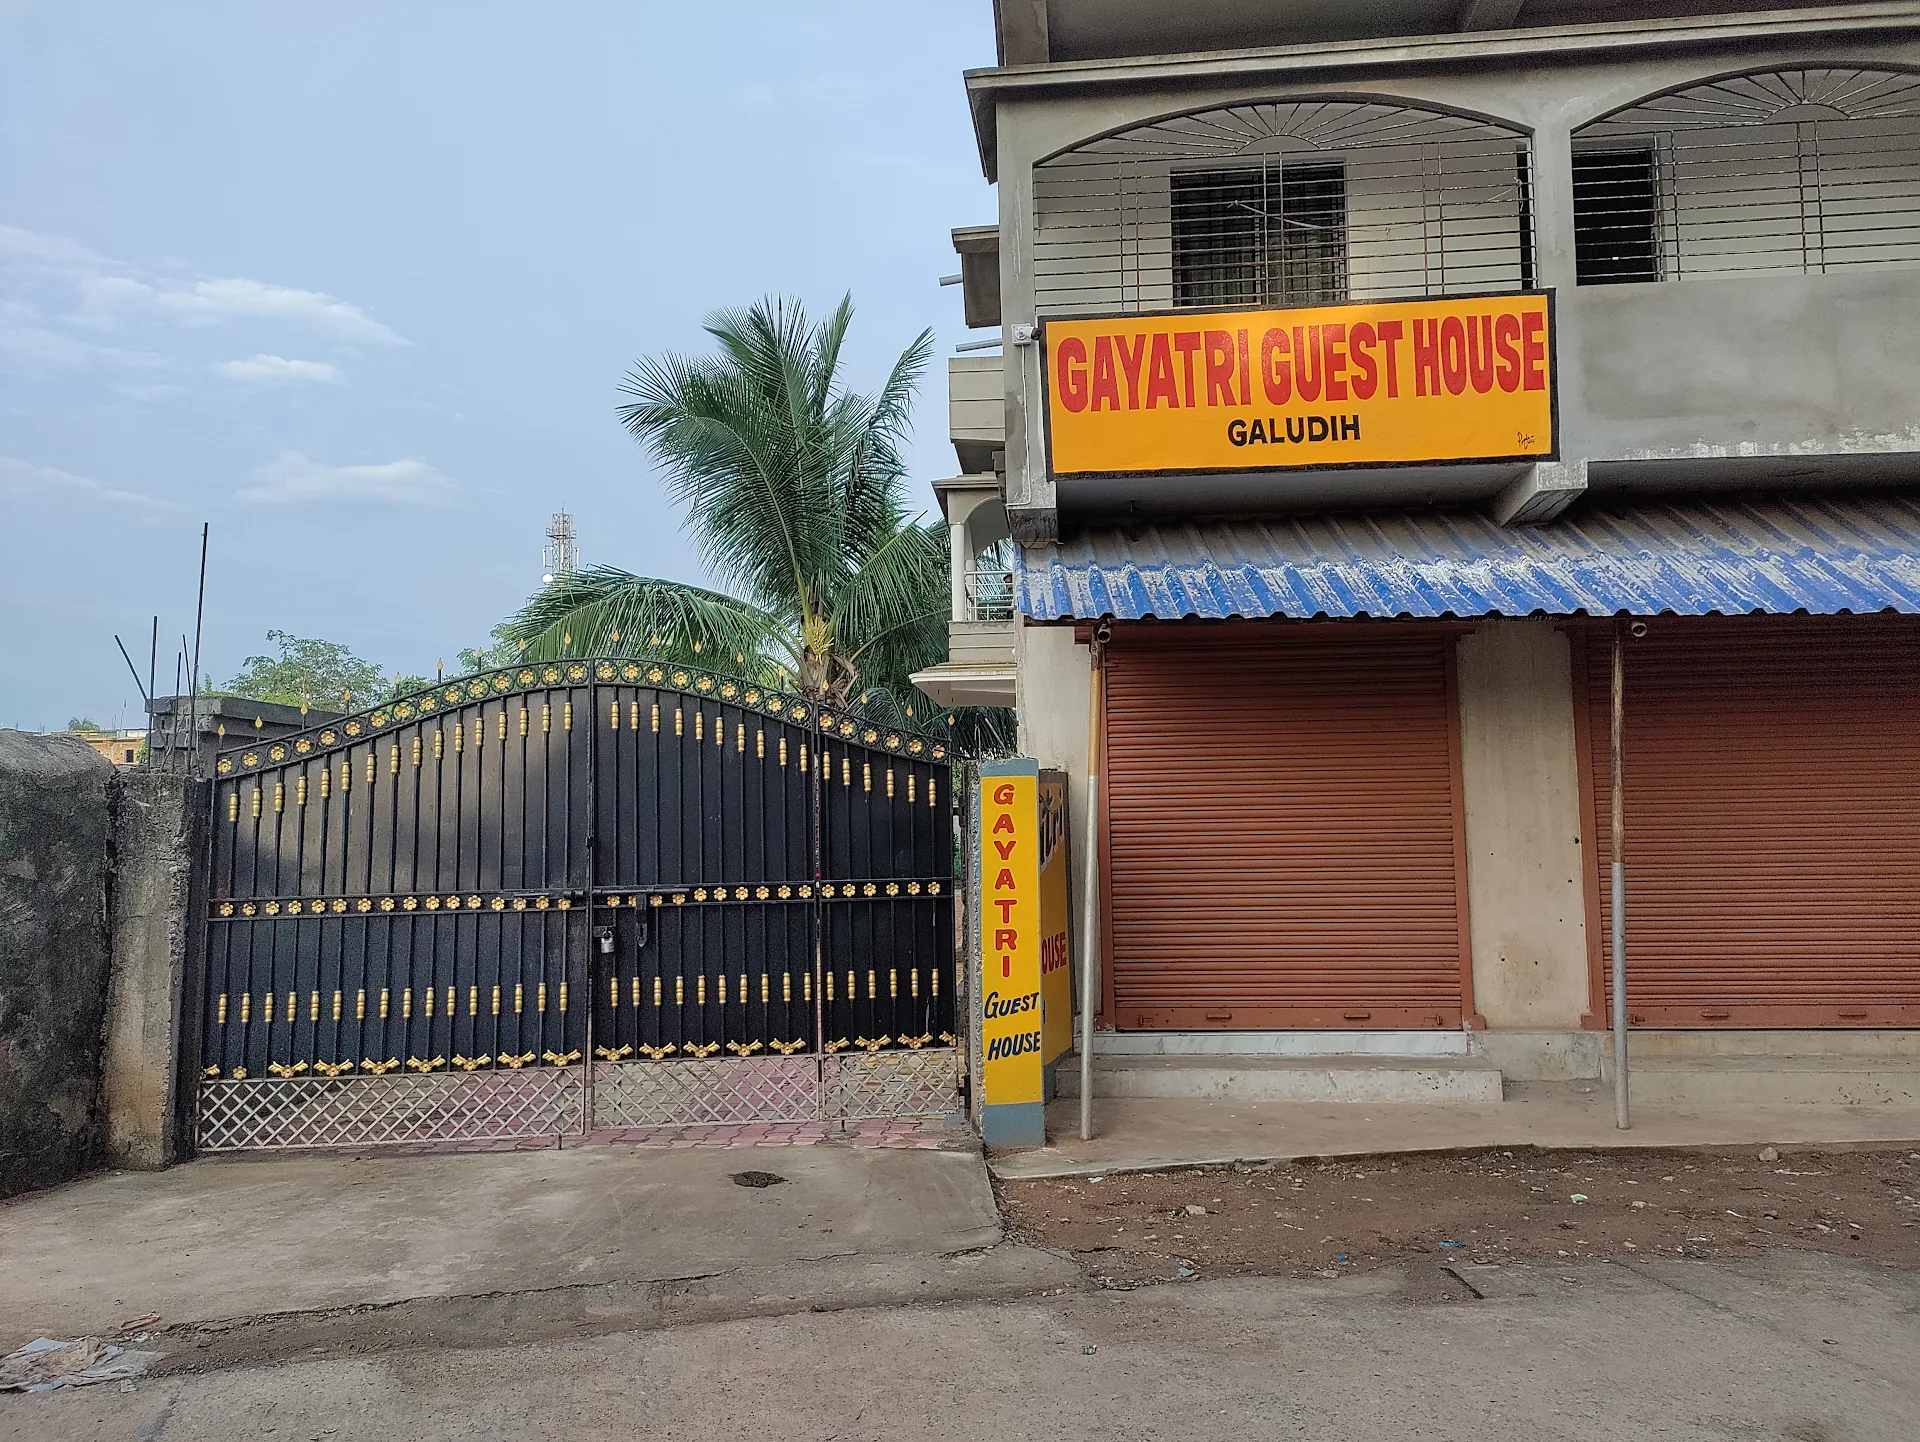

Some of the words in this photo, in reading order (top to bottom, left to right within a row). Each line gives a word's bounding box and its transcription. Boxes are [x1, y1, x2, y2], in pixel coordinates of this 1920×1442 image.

[1056, 328, 1252, 414] GAYATRI
[1261, 320, 1404, 406] GUEST
[1413, 311, 1546, 398] HOUSE
[1227, 414, 1361, 447] GALUDIH
[992, 783, 1018, 979] GAYATRI
[1041, 931, 1067, 975] OUSE
[983, 990, 1040, 1019] GUEST
[987, 1031, 1041, 1062] HOUSE
